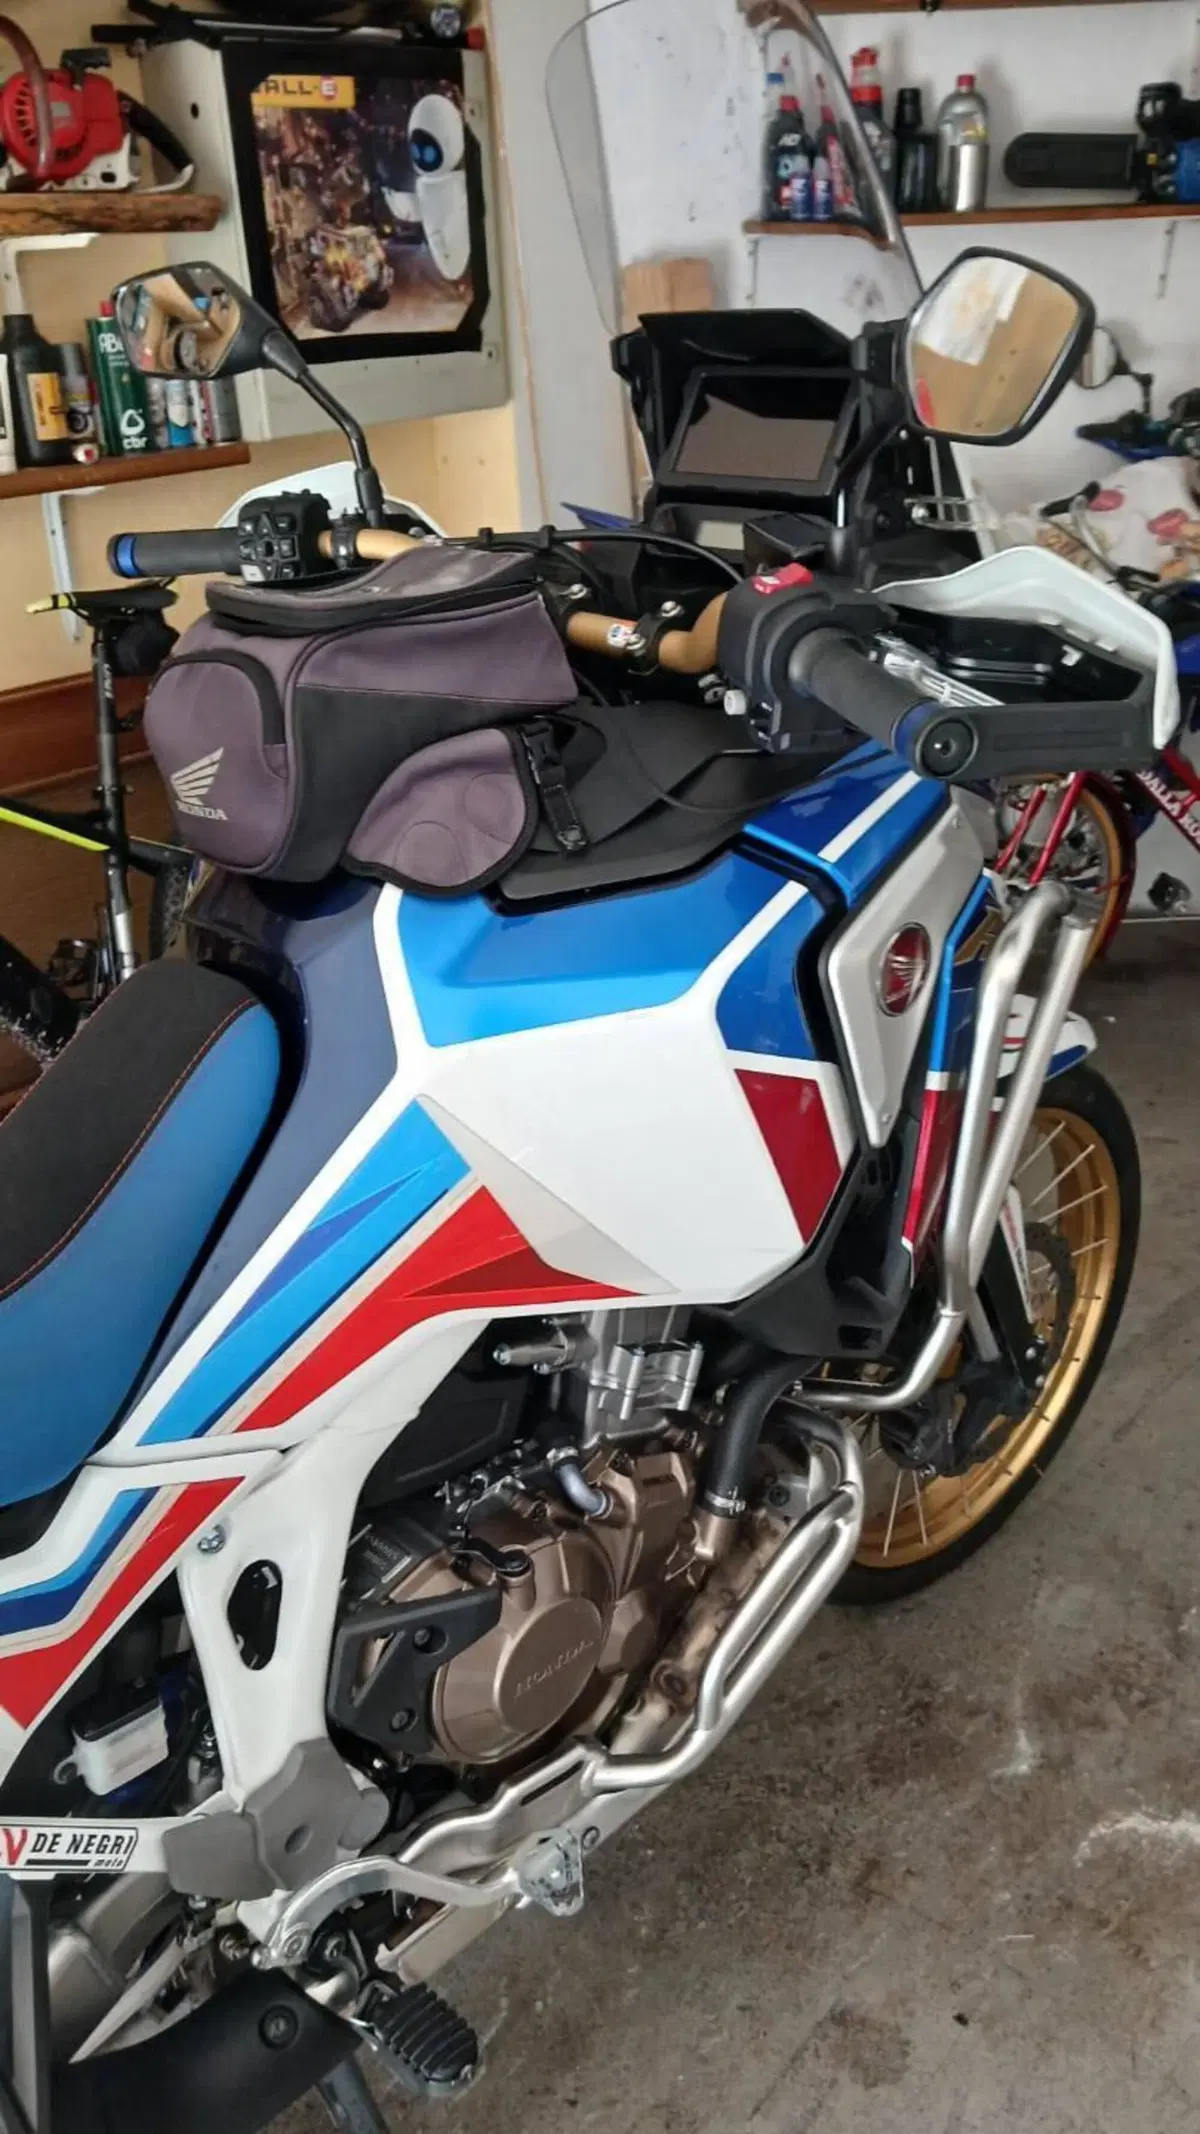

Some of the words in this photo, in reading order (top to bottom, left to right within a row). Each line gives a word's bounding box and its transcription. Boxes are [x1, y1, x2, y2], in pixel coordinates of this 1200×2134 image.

[260, 79, 338, 98] ALL-E
[30, 1833, 62, 1854] DE
[66, 1833, 135, 1855] NEGRI
